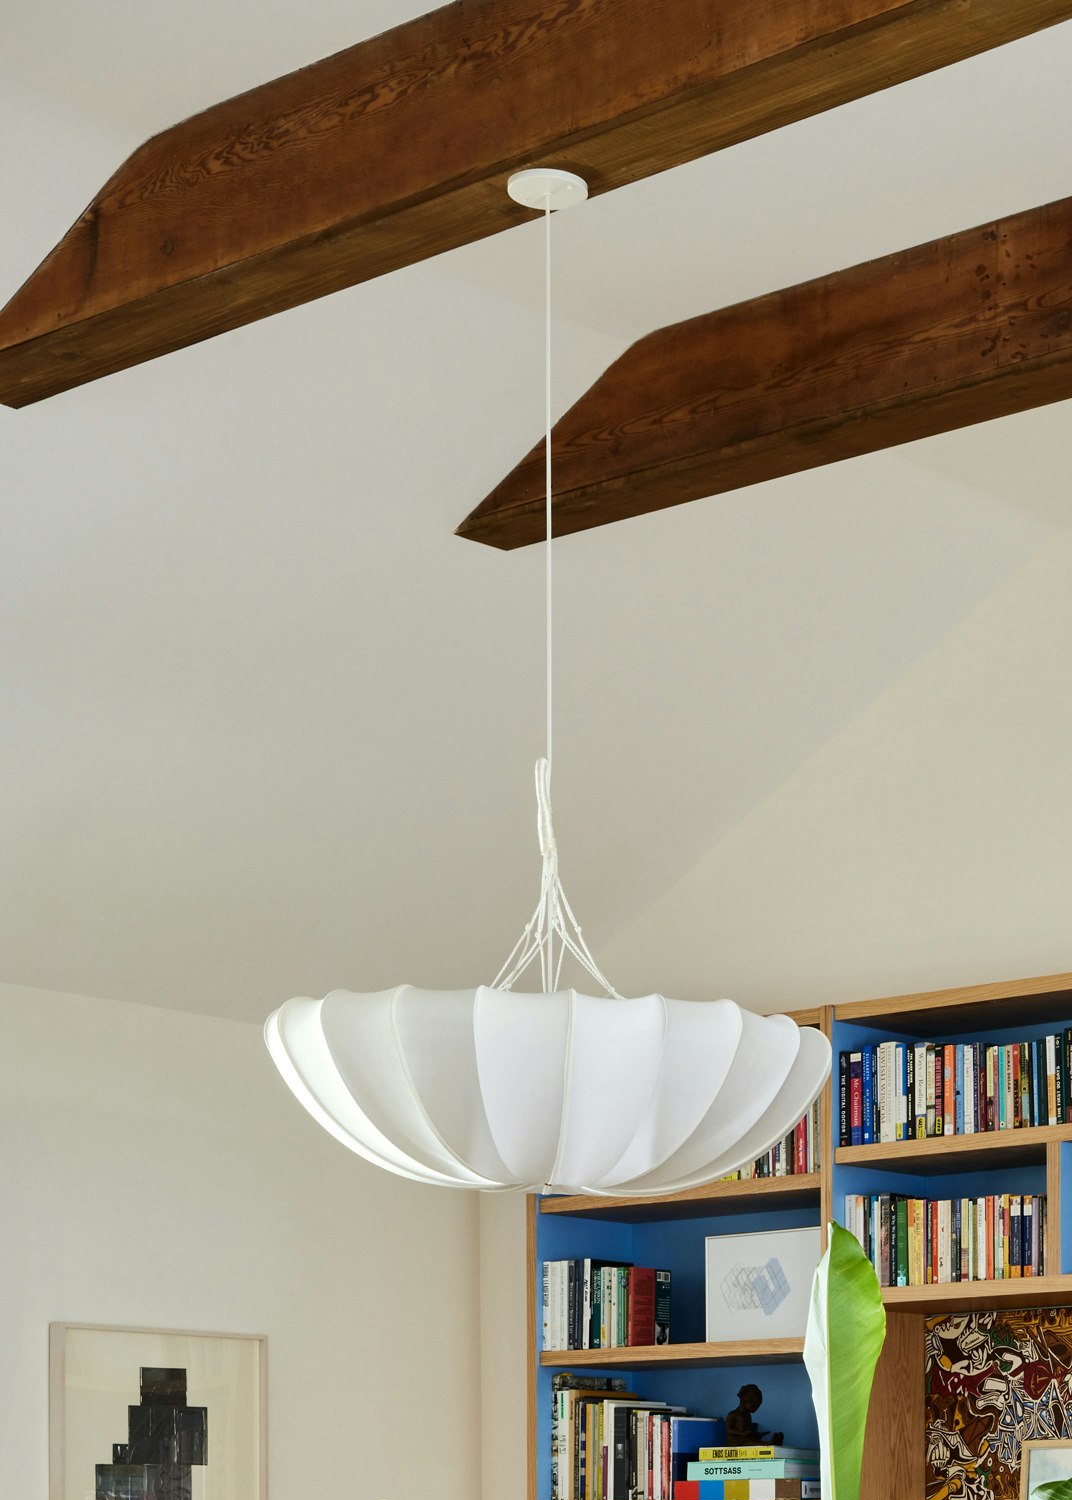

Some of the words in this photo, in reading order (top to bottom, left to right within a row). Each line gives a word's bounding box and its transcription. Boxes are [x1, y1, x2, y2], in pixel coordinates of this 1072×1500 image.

[712, 1450, 723, 1458] ENDS
[725, 1448, 738, 1458] EARTH
[704, 1467, 741, 1475] SOTTSASS
